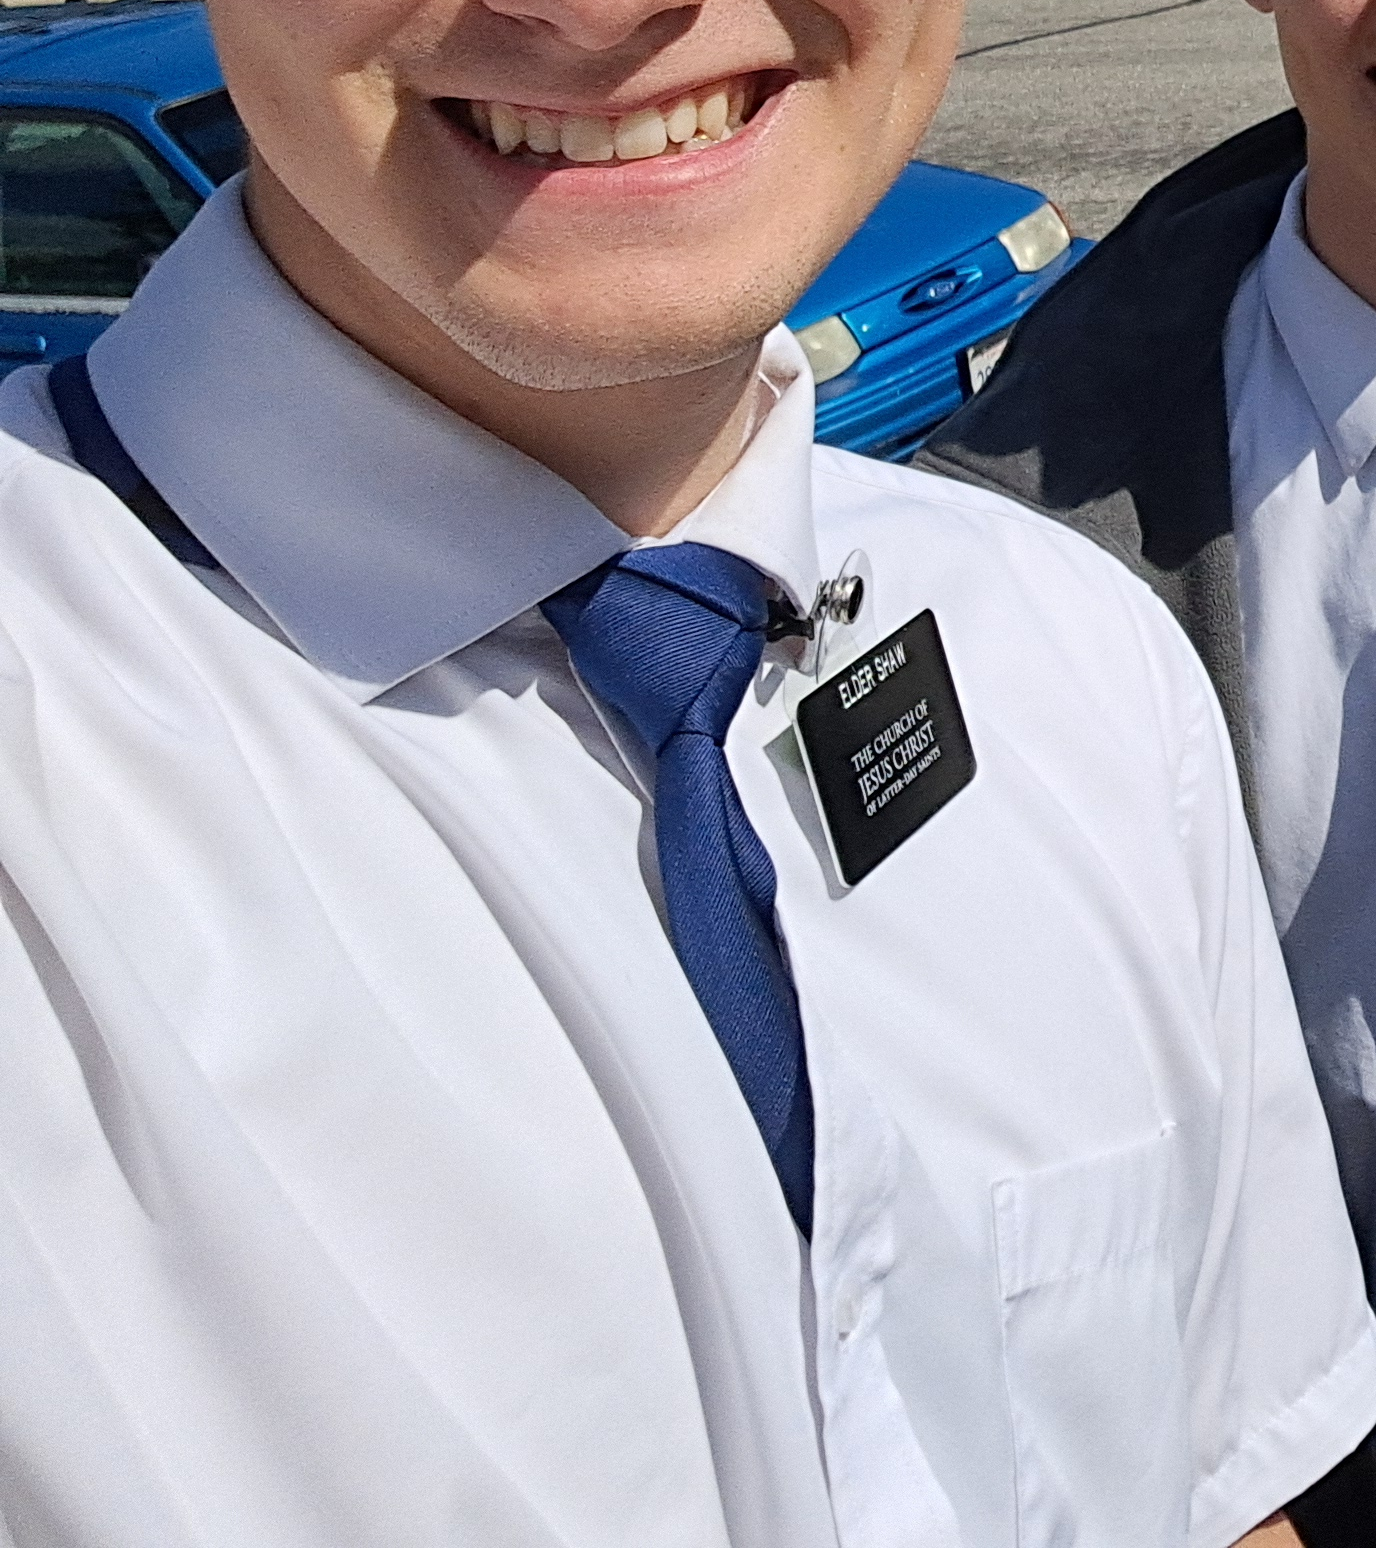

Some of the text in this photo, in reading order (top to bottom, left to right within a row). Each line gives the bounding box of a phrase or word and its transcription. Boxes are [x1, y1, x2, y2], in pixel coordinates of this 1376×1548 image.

[838, 641, 907, 709] ELDER SHAW
[850, 698, 928, 772] THE CHURCH OF
[857, 719, 935, 805] JESUS CHRIST
[866, 745, 941, 817] OF LATTER-DAY SAINTS
